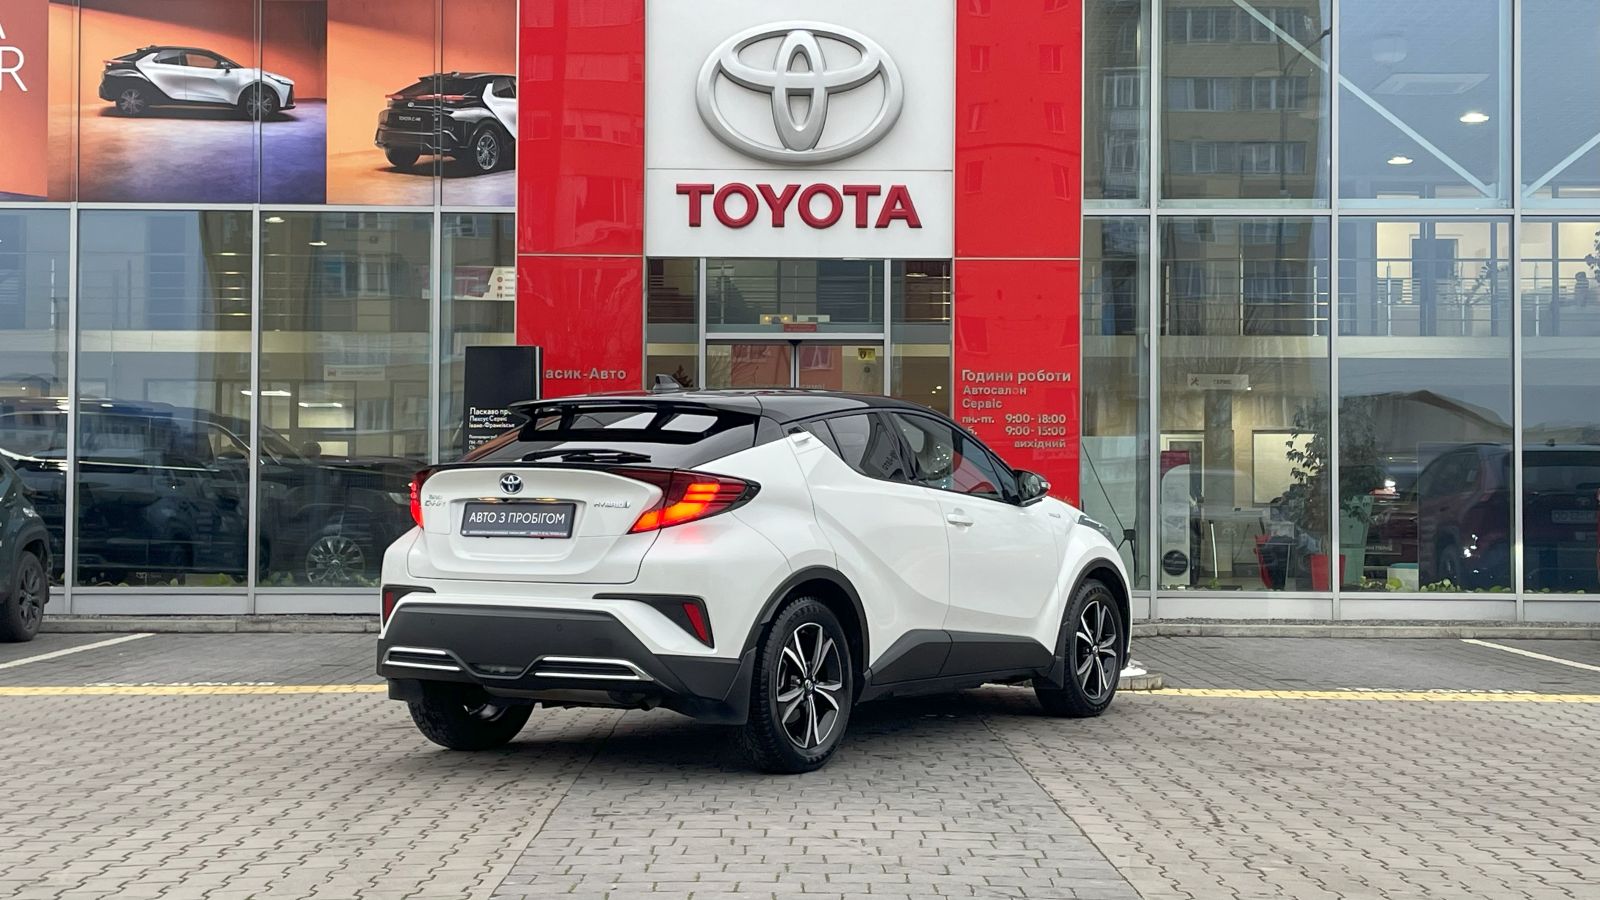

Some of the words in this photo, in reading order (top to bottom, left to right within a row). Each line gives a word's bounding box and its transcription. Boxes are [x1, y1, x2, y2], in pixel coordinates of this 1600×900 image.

[676, 182, 922, 229] TOYOTA
[962, 369, 1013, 383] Години
[1018, 369, 1071, 384] роботи
[963, 385, 1027, 395] Автосалон
[962, 399, 1003, 410] Сервіс
[1005, 413, 1030, 424] 9:00
[1038, 414, 1067, 424] 18:00
[1005, 426, 1030, 436] 9:00
[1038, 426, 1067, 436] 15:00
[1014, 439, 1067, 449] вихідний
[469, 512, 496, 523] АВТО
[508, 512, 565, 524] ПРОБІГОМ
